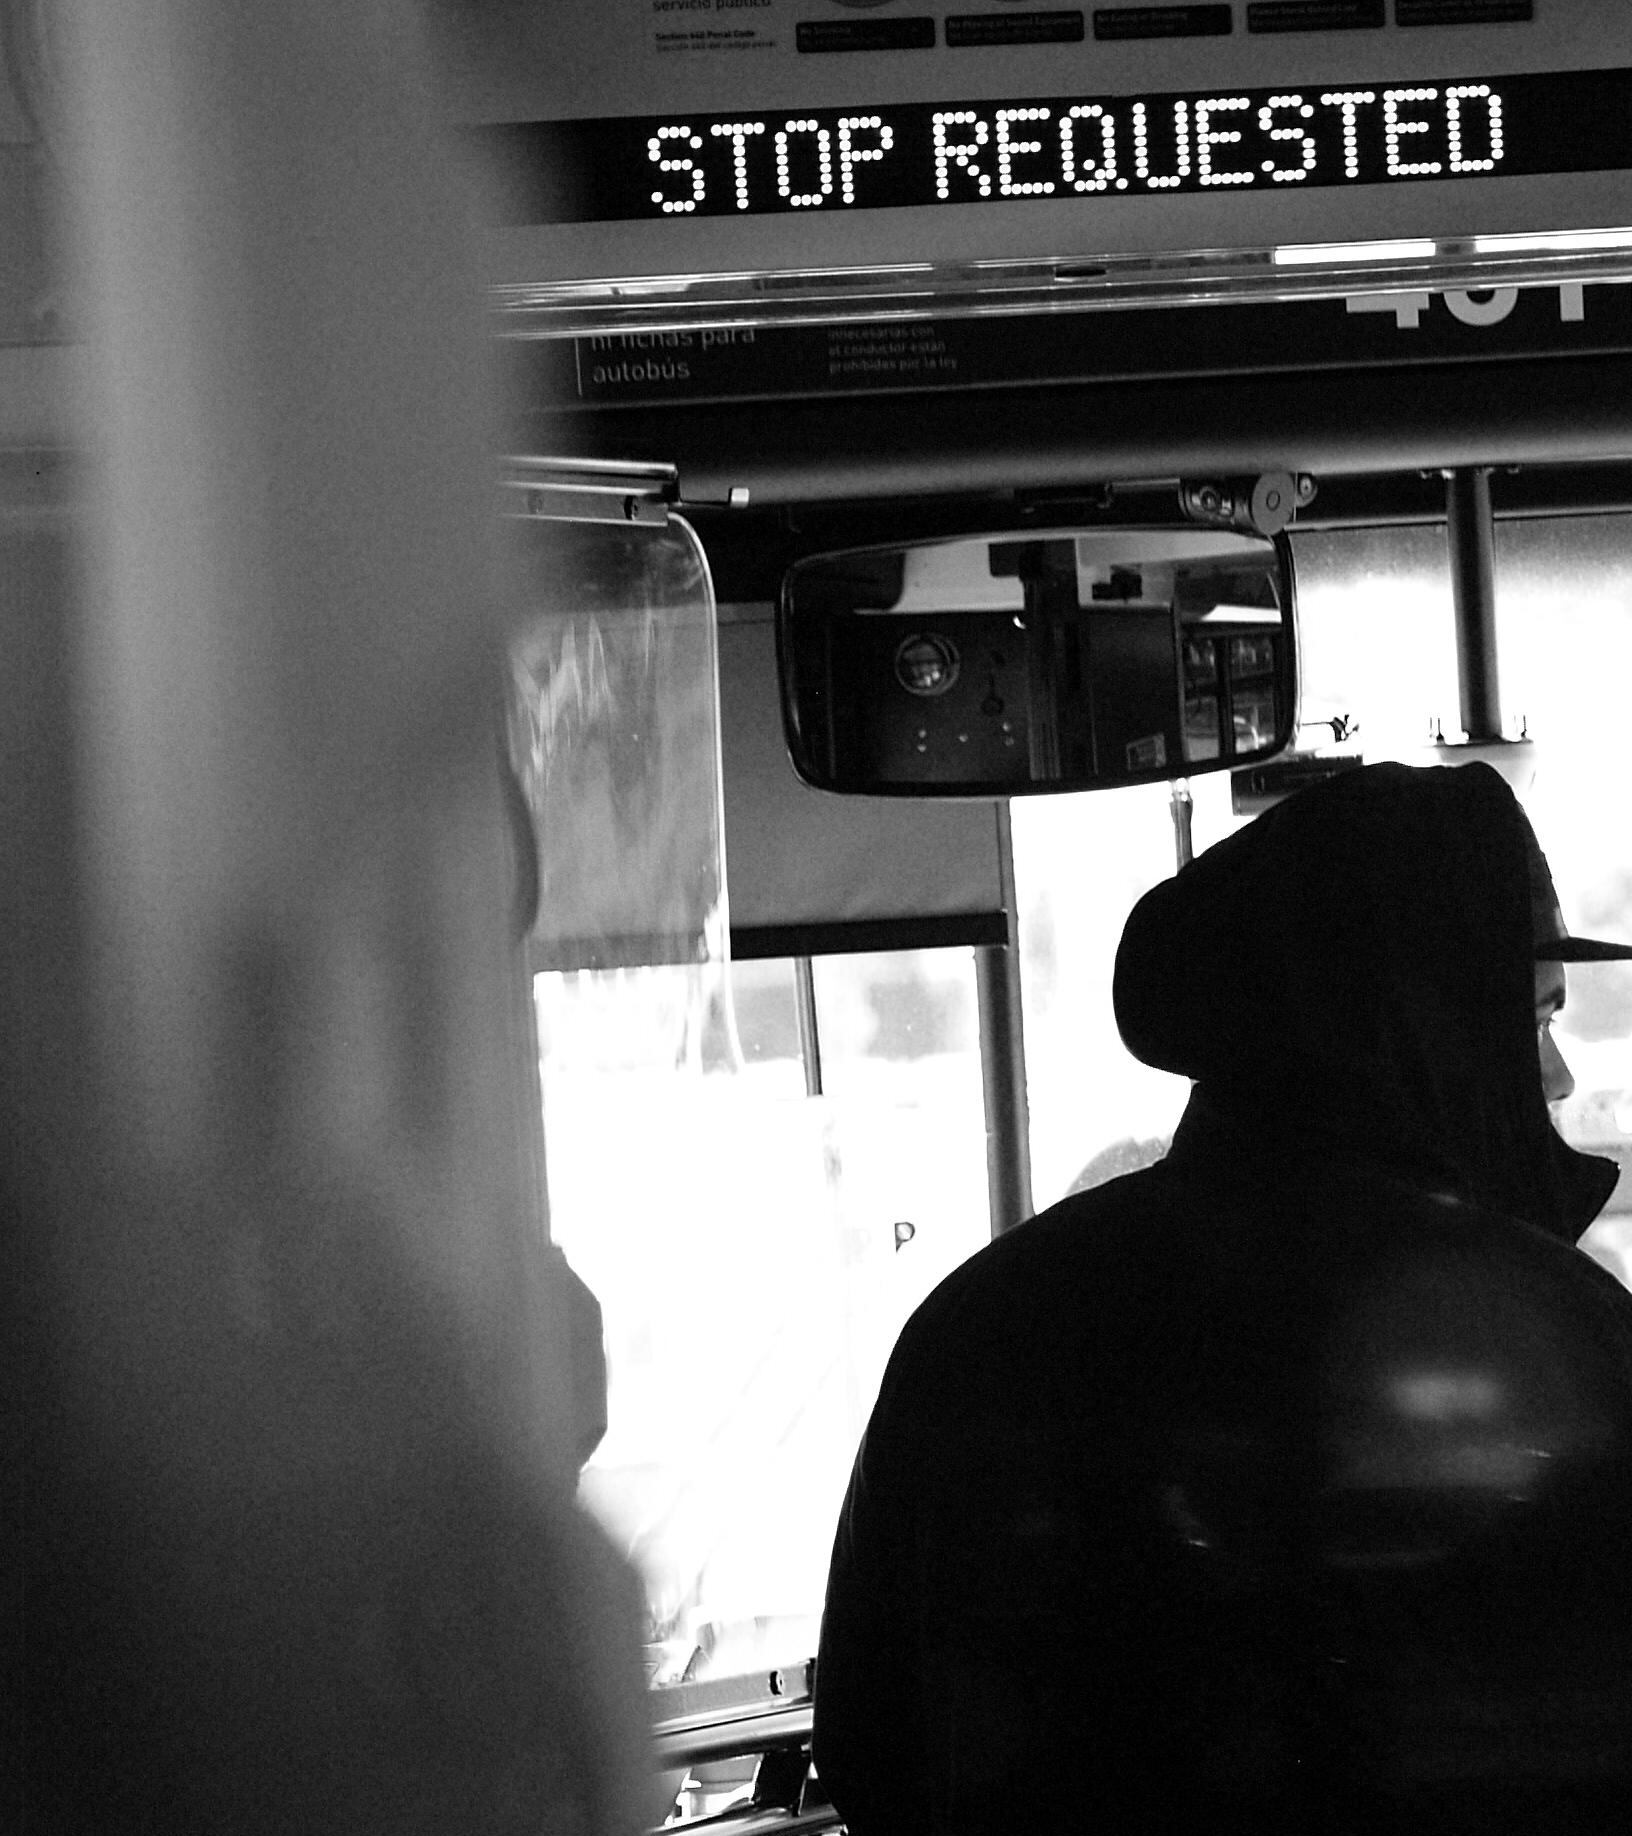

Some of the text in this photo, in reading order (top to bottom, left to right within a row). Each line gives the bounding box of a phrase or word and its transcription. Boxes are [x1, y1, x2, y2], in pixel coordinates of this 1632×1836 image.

[648, 85, 1503, 212] STOP REQUESTED
[702, 328, 756, 351] para
[593, 355, 690, 383] autobús
